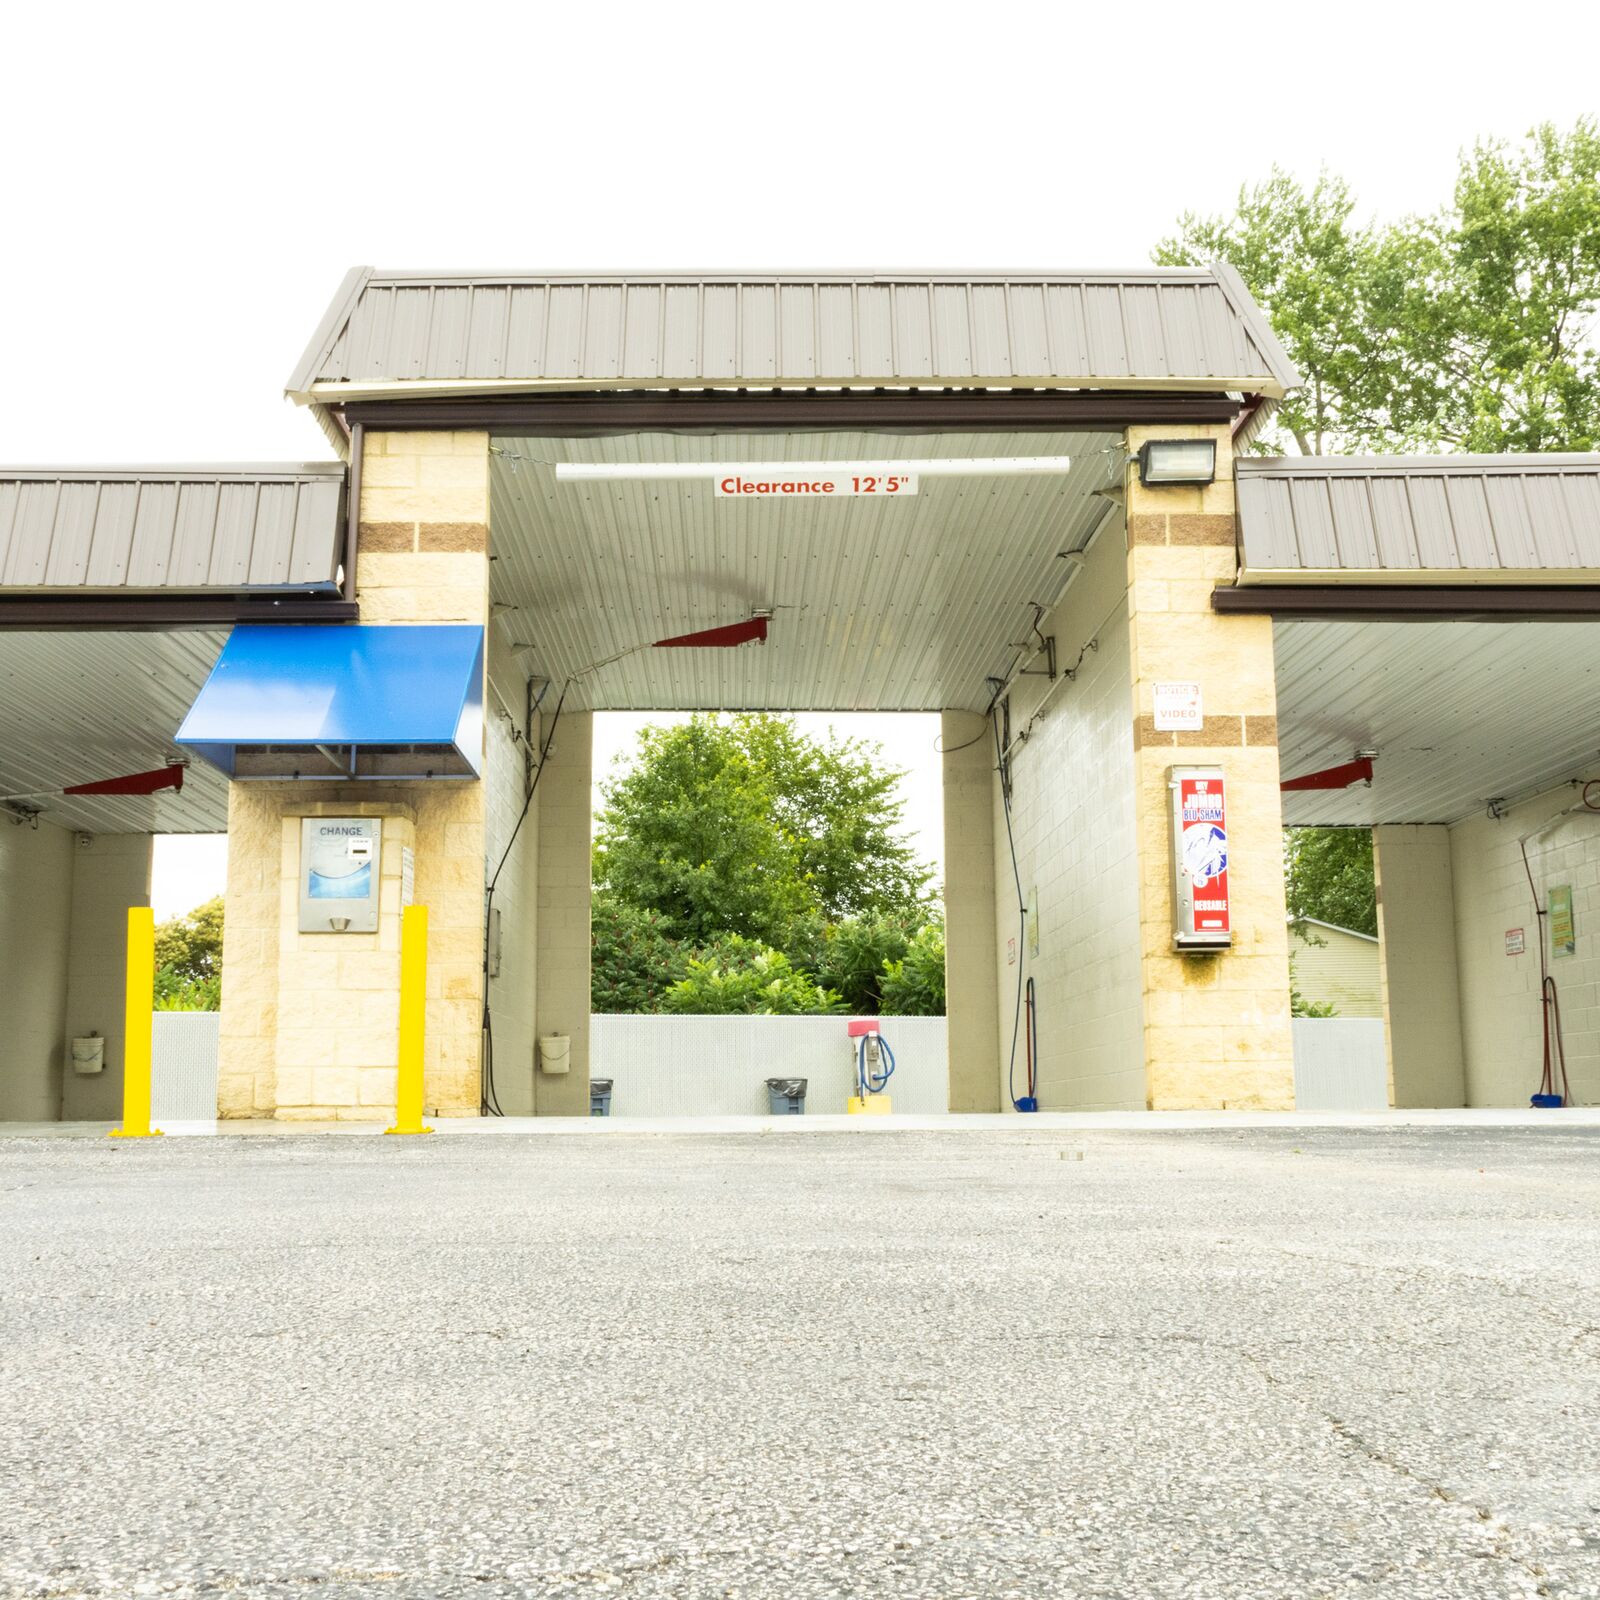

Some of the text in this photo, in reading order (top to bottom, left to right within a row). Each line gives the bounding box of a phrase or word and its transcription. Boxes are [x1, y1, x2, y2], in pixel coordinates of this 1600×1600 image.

[721, 477, 835, 493] Clearance
[1160, 710, 1197, 718] VIDEO
[1184, 793, 1222, 808] JUMBO
[320, 827, 363, 836] CHANGE
[1194, 900, 1227, 911] REUSABLE
